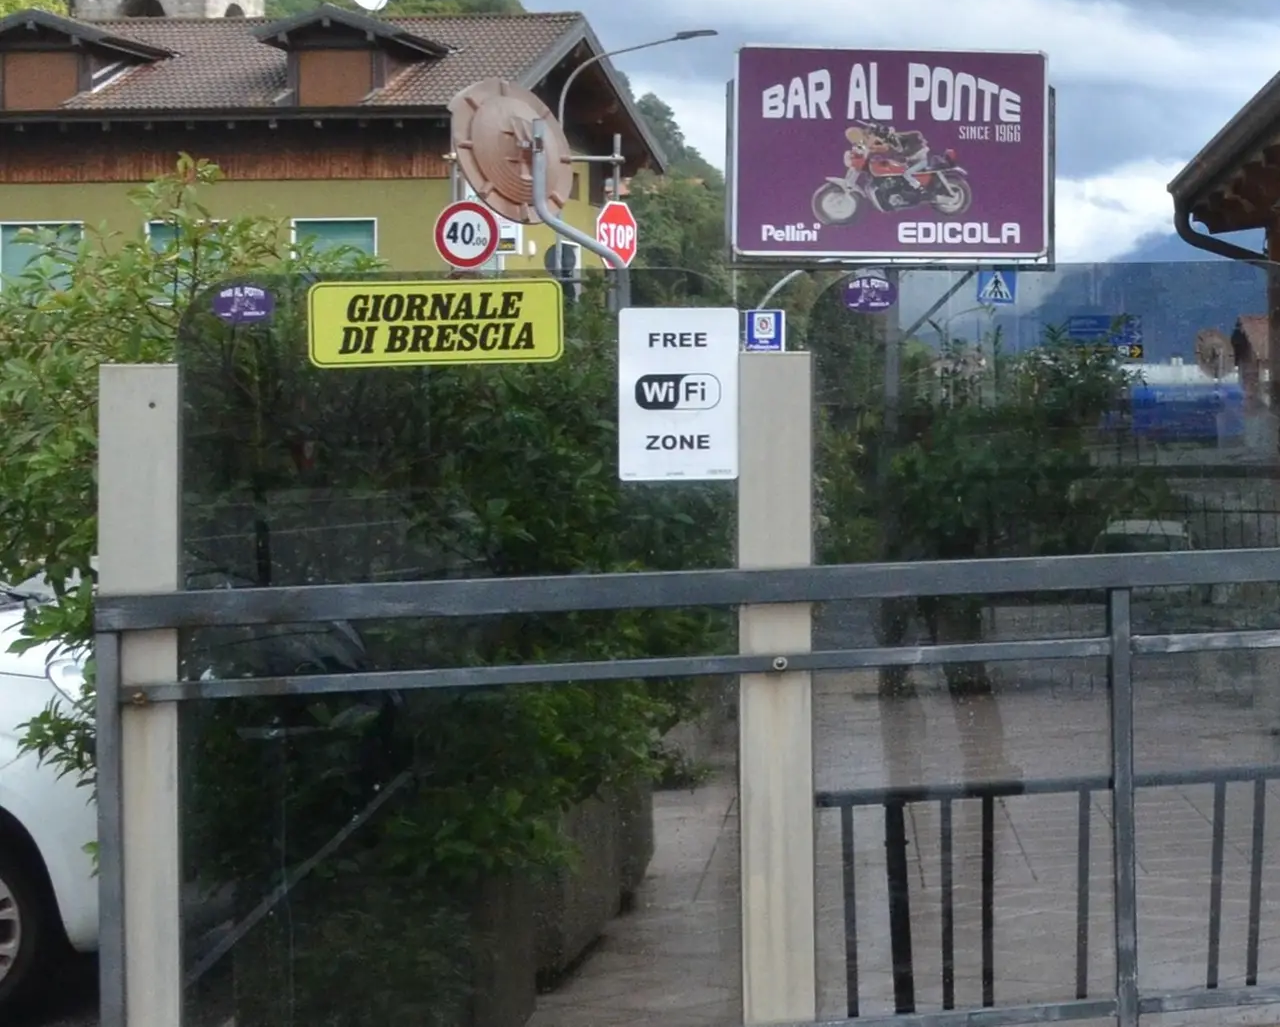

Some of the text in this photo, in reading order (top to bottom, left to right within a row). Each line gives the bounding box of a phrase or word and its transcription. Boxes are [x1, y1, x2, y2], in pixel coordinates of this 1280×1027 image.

[762, 62, 1021, 122] BAR AL PONTE
[959, 124, 1021, 142] SINCE 1966
[600, 224, 634, 248] STOP
[761, 222, 1021, 244] Pellini EDICOLA
[347, 291, 524, 322] GIORNALE
[339, 322, 535, 354] DI BRESCIA
[648, 332, 708, 348] FREE
[642, 381, 706, 403] WiFi
[645, 434, 711, 450] ZONE
